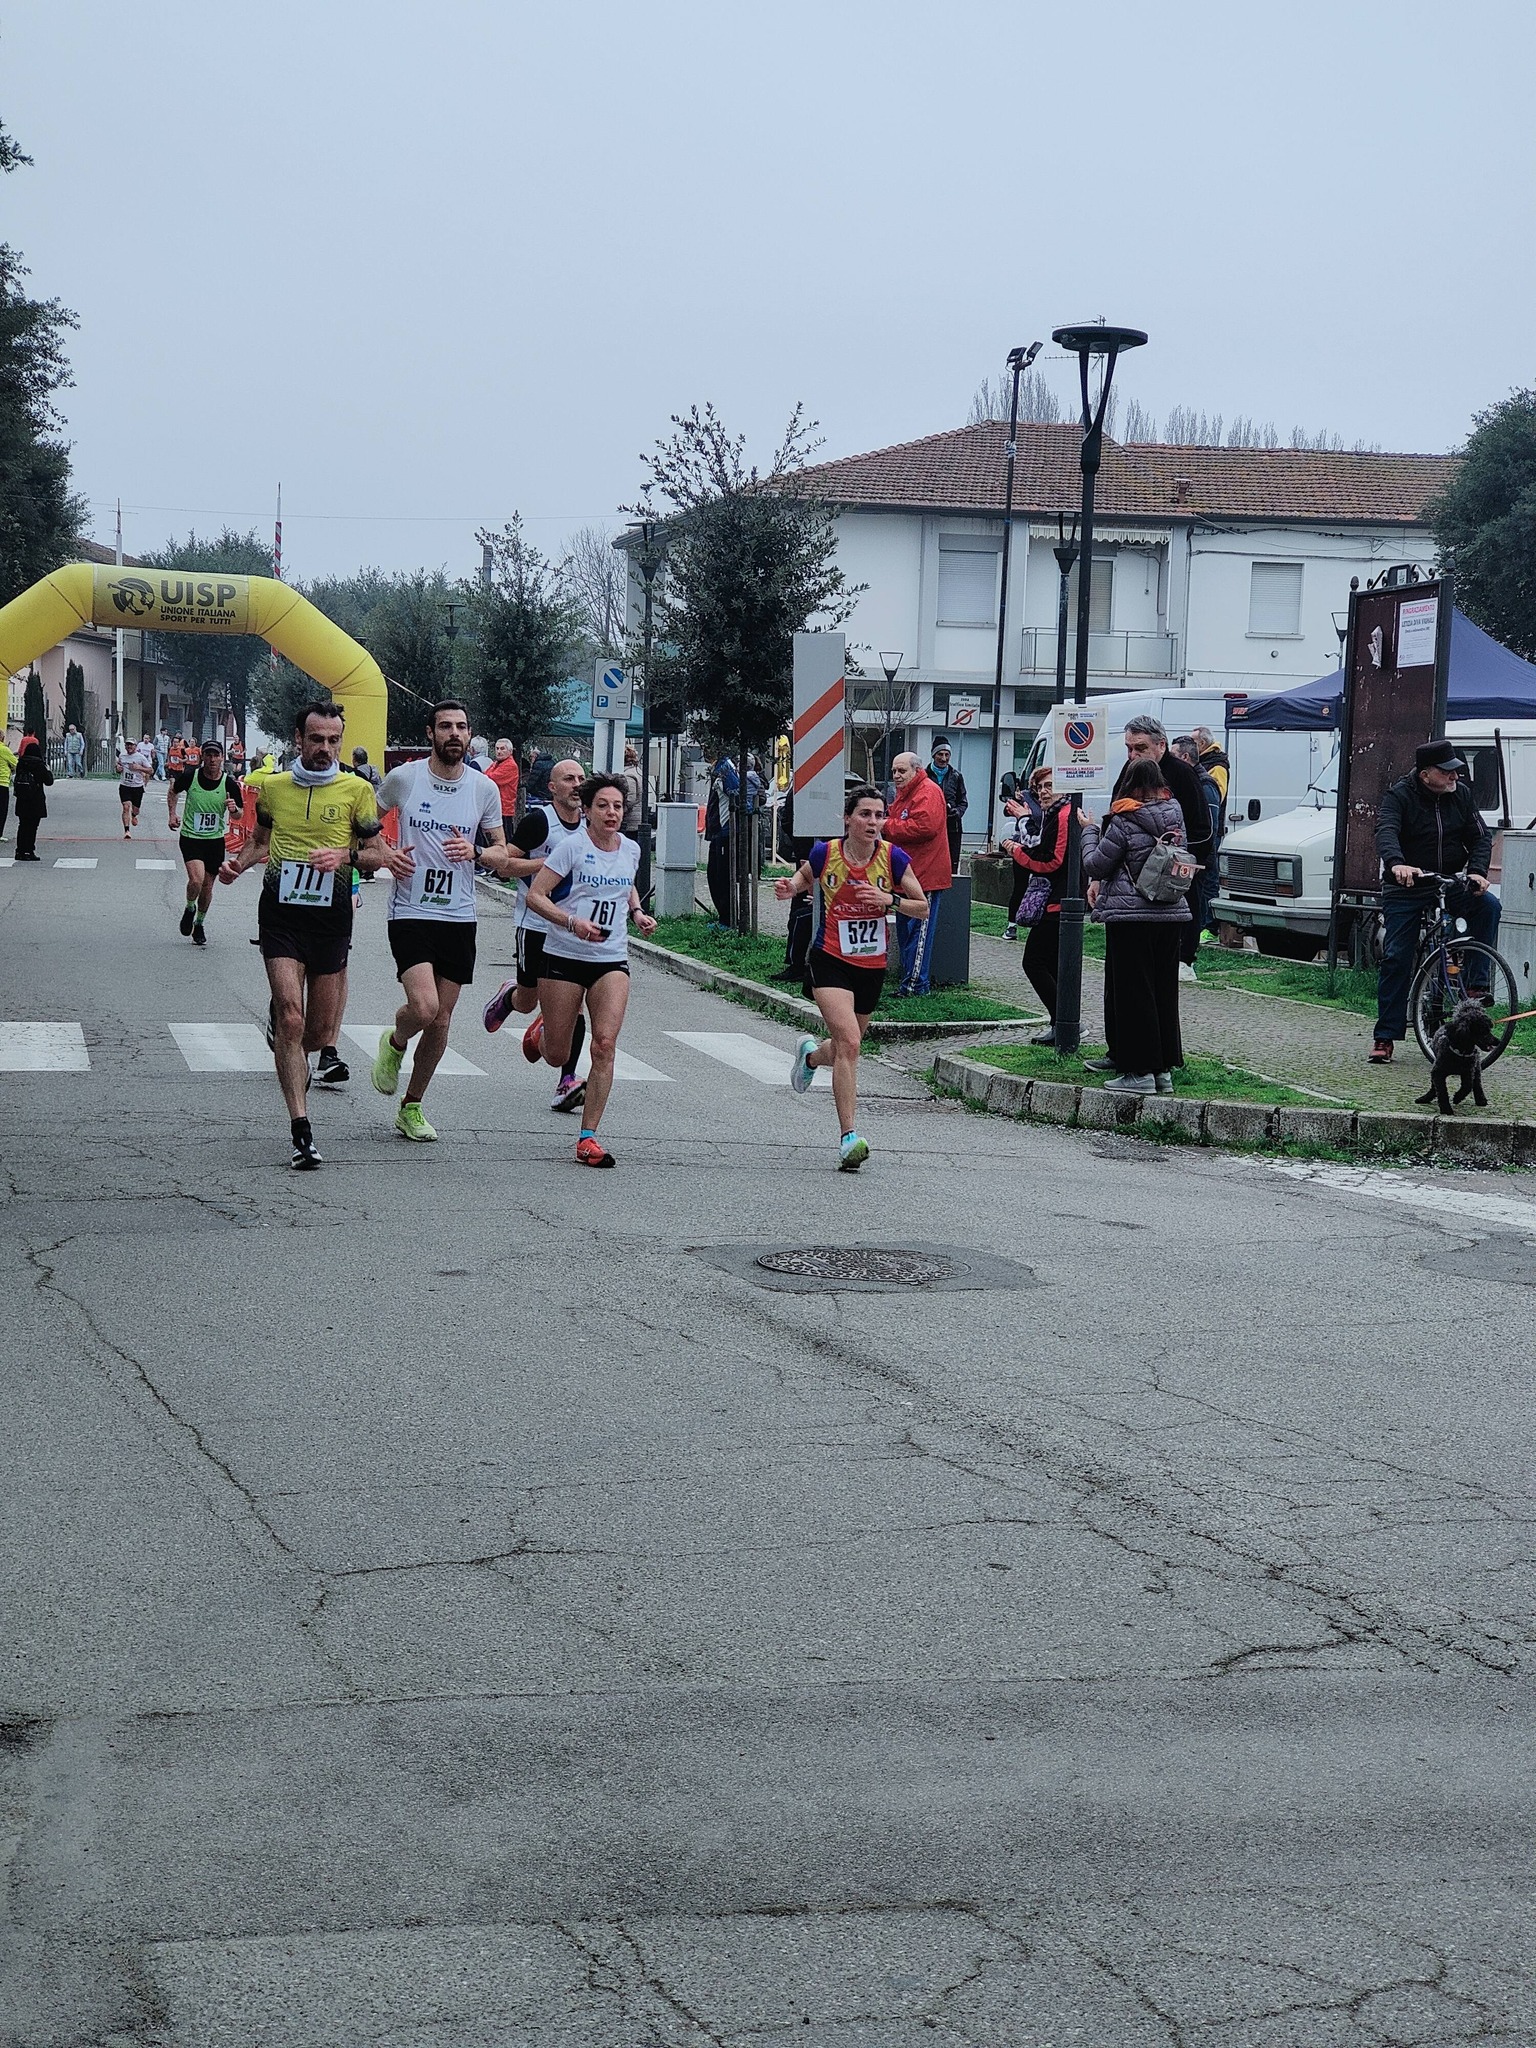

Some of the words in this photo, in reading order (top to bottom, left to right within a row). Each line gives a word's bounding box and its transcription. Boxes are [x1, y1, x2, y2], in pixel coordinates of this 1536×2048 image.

[161, 580, 236, 607] UISP
[160, 606, 194, 615] UNIONE
[197, 609, 236, 618] ITALIANA
[160, 615, 187, 623] SPORT
[191, 616, 205, 624] PER
[599, 697, 606, 706] P
[200, 813, 216, 826] 758
[409, 816, 471, 835] lughesna
[424, 868, 454, 895] 621
[590, 899, 617, 926] 767
[848, 919, 878, 945] 522
